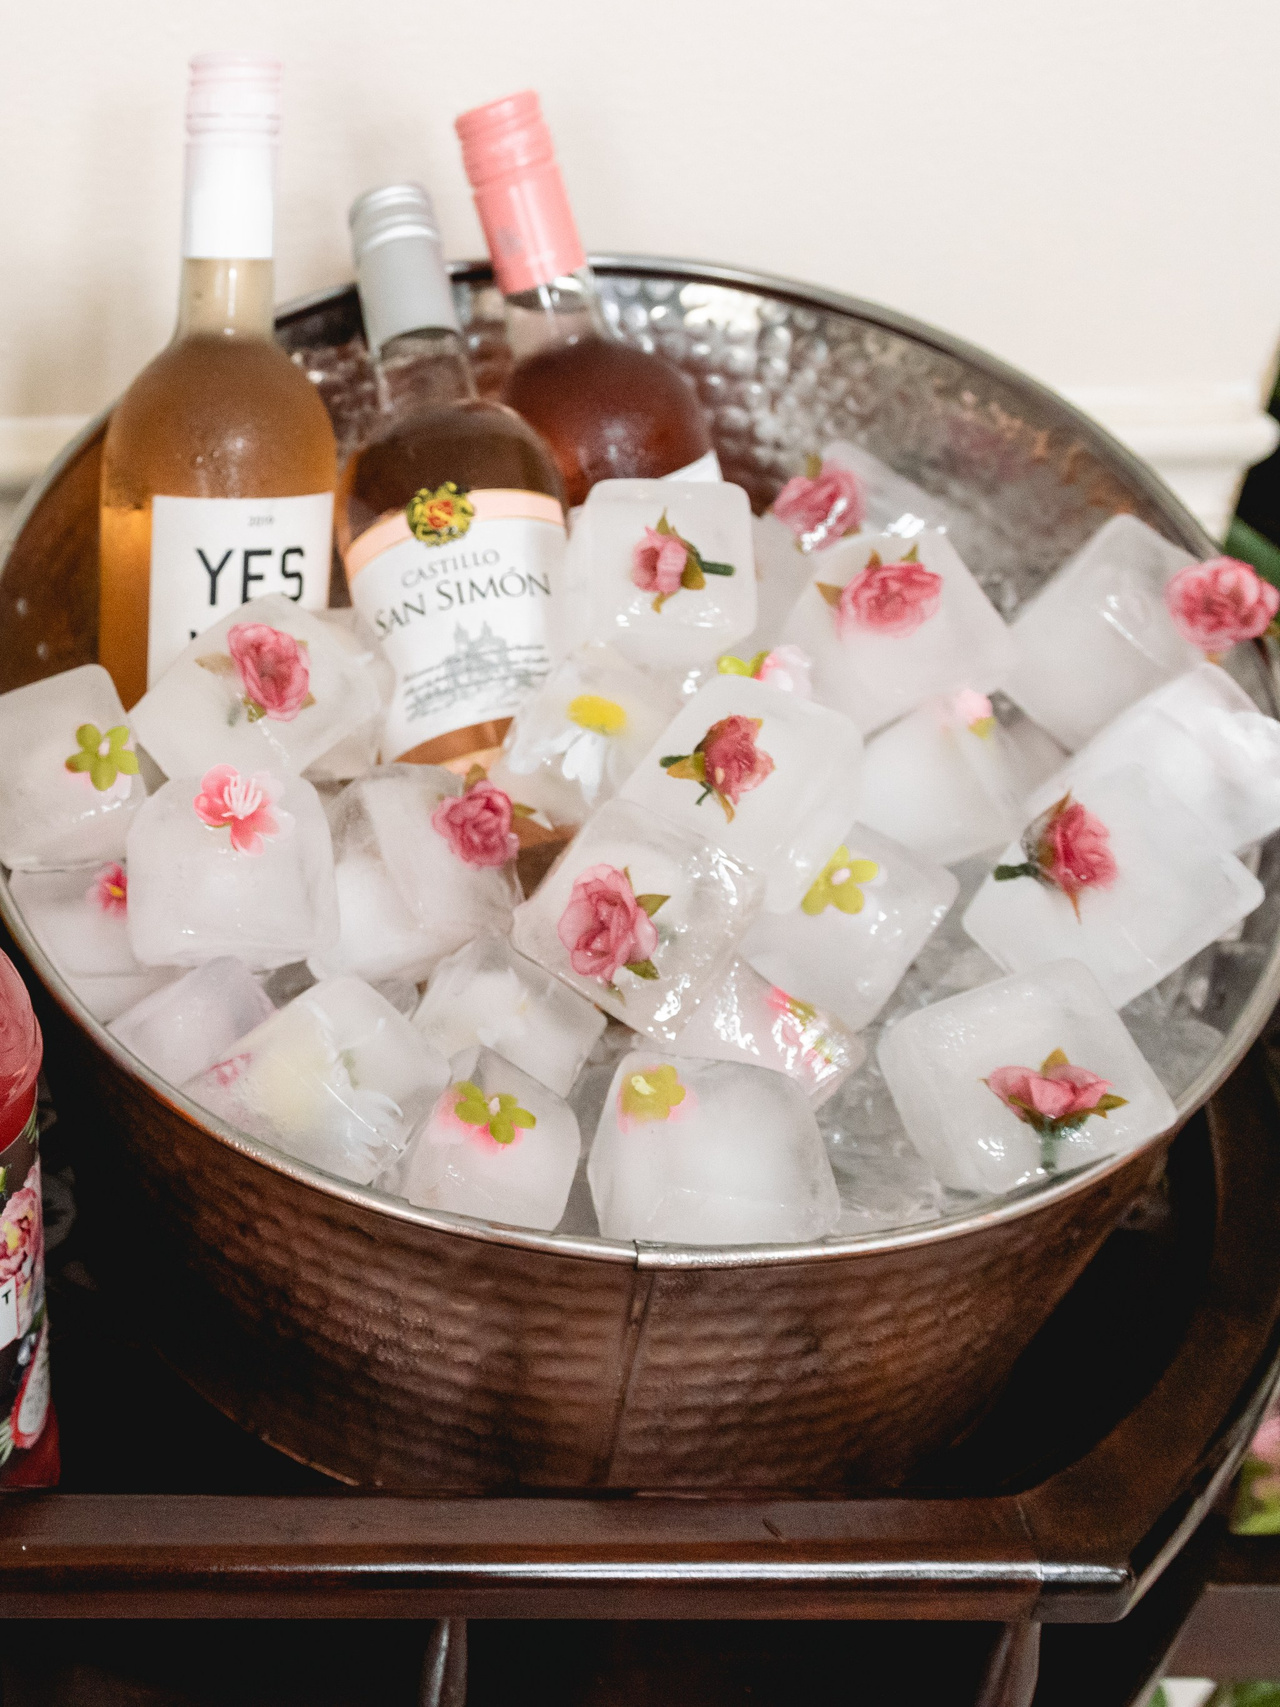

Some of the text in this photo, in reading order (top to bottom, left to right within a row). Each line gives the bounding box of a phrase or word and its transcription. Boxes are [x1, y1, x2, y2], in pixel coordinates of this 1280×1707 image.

[196, 546, 304, 606] YES
[401, 549, 500, 588] CASTILLO
[374, 566, 552, 641] SAN SIMÓN
